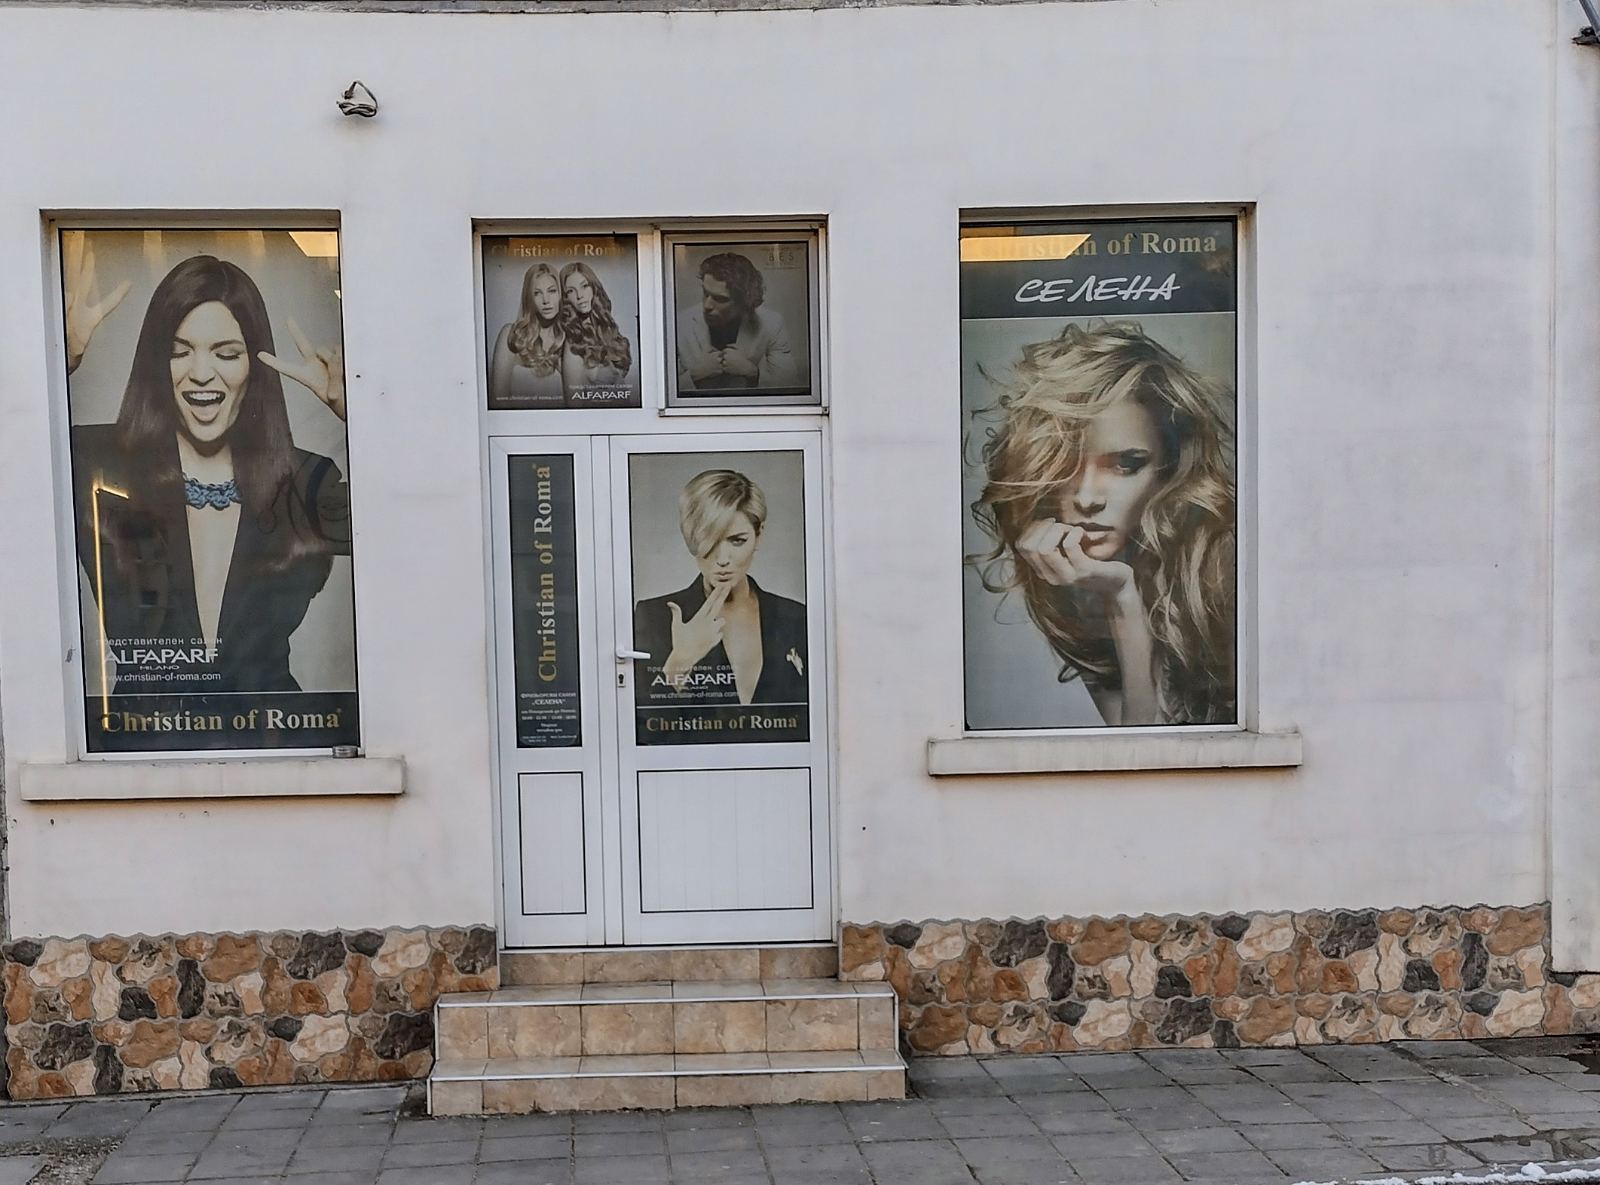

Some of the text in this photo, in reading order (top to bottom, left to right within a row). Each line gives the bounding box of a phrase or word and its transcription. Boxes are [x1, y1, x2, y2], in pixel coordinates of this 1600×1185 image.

[564, 243, 580, 257] of
[978, 232, 1216, 258] ristin of Roma
[1014, 272, 1181, 303] СЕЛЕНА
[571, 390, 632, 400] ALFAPARF
[533, 466, 558, 683] Christian of Roma
[98, 637, 223, 646] едставителен сан
[105, 648, 219, 665] ALFAPARF
[647, 665, 712, 673] преавелен
[106, 672, 221, 682] w.christian-of-roma.com
[650, 673, 737, 686] ALFAPARF
[101, 708, 340, 733] Christian of Roma
[646, 715, 797, 732] Christian of Roma
